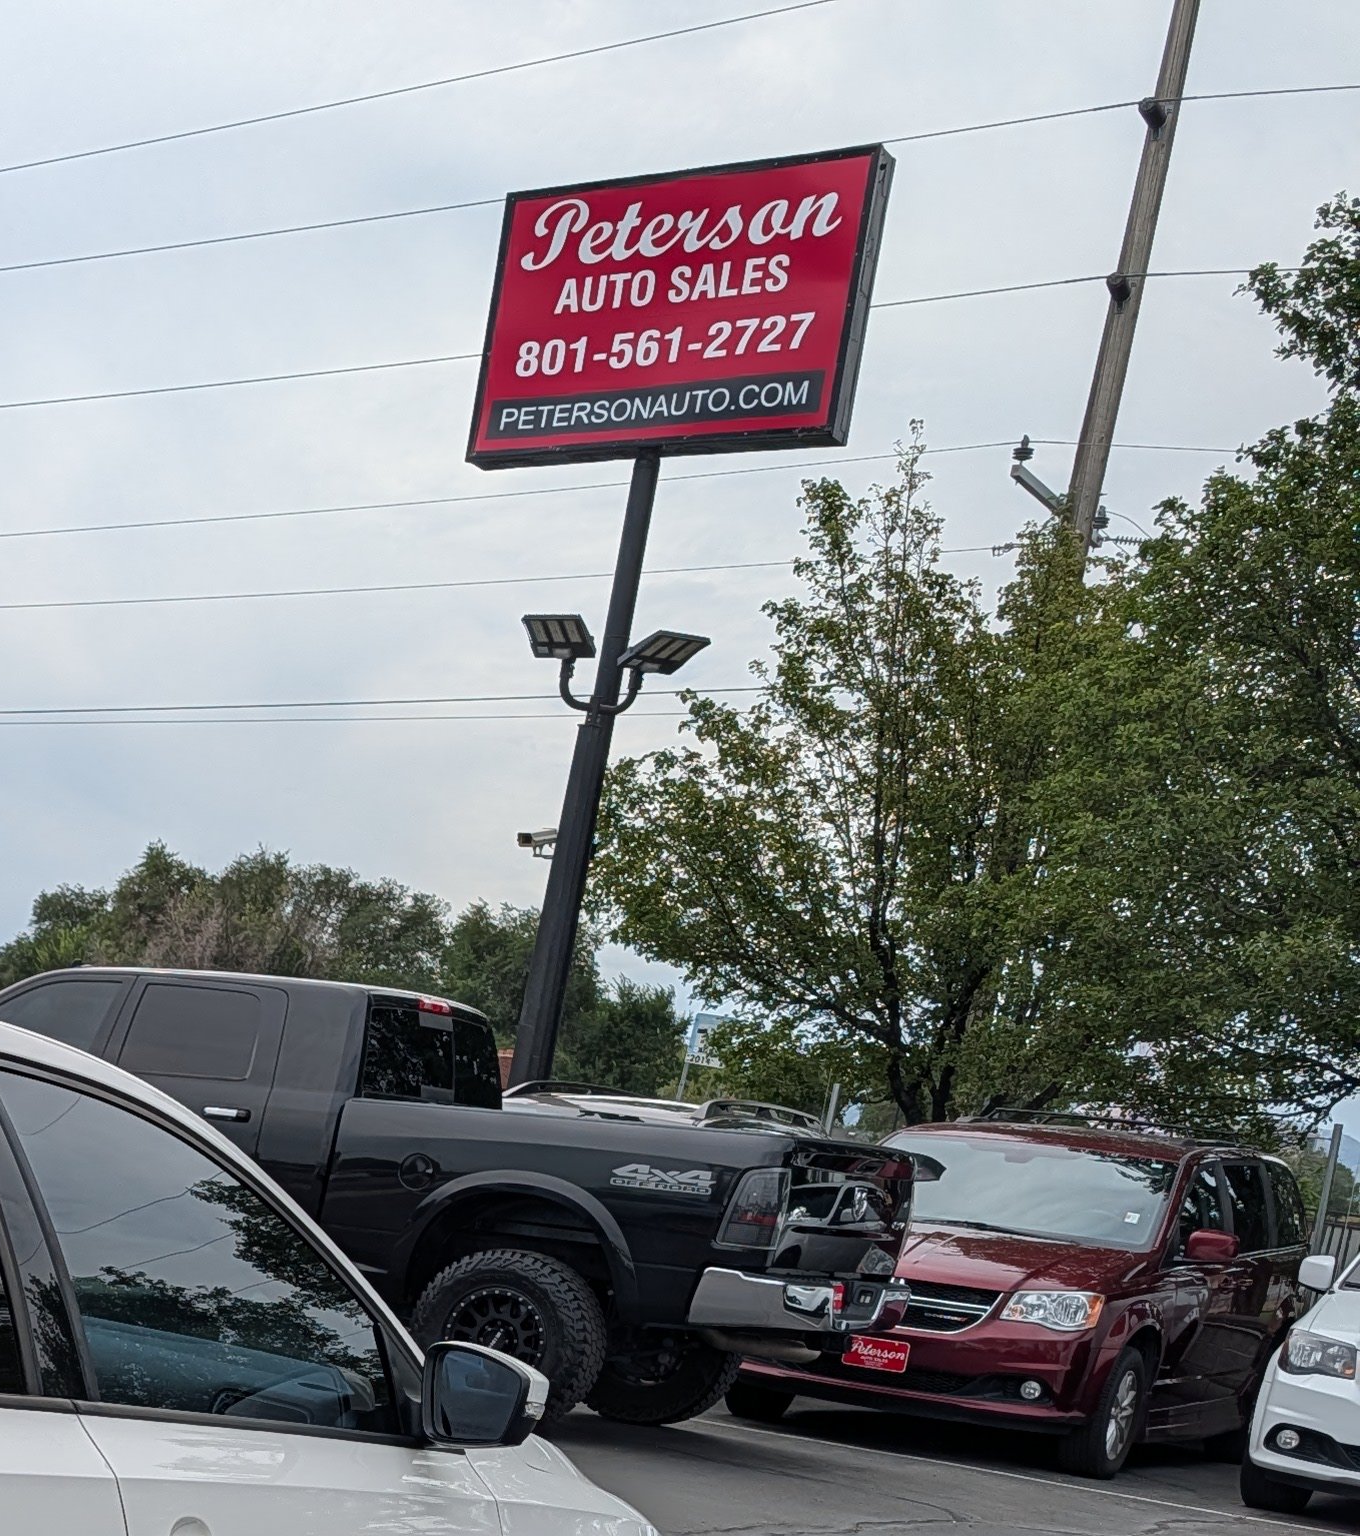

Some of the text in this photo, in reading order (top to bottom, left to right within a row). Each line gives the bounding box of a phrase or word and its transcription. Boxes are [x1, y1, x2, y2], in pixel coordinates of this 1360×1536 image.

[521, 191, 842, 272] Peterson
[554, 254, 790, 315] AUTO SALES
[515, 311, 816, 378] 801-561-2727
[498, 380, 810, 431] PETERSONAUTO.COM
